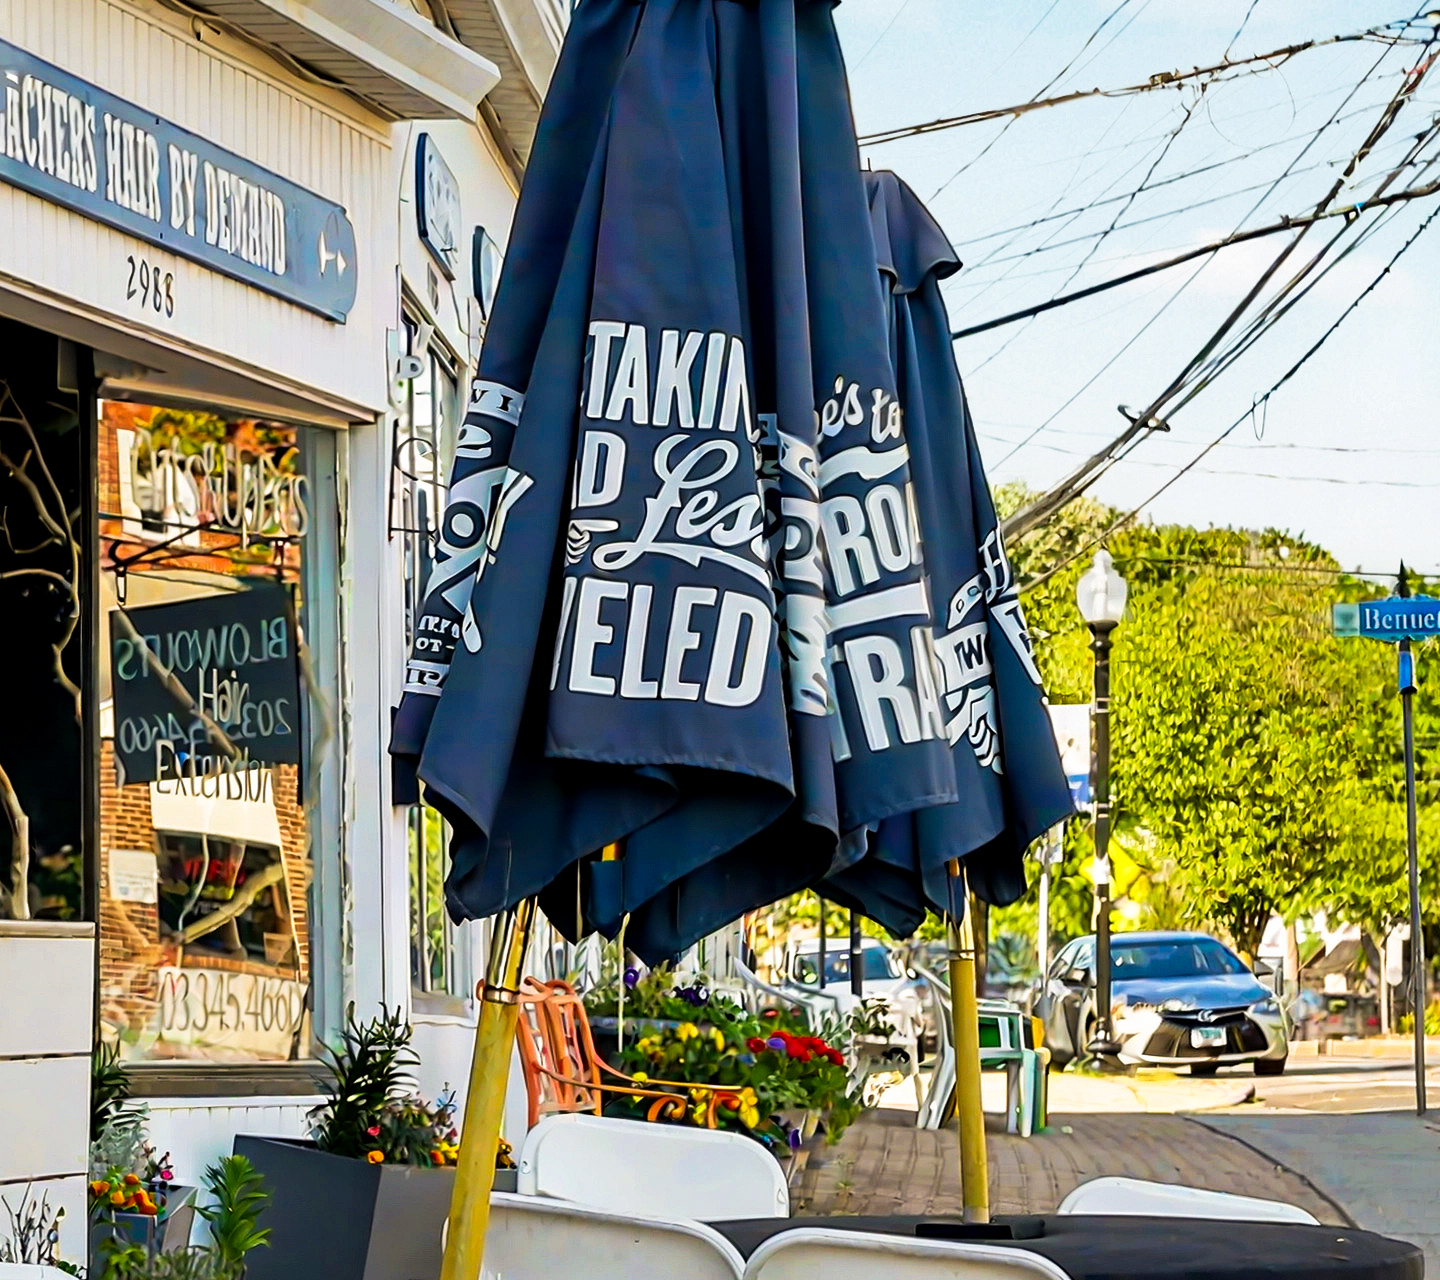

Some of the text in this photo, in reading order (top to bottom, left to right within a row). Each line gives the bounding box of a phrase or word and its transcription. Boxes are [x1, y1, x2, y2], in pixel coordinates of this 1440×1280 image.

[103, 112, 162, 223] HAIR
[168, 142, 199, 237] BY
[203, 160, 287, 276] DEMAND
[586, 320, 754, 442] TAKIN
[592, 434, 768, 571] Les
[198, 667, 250, 722] Hair
